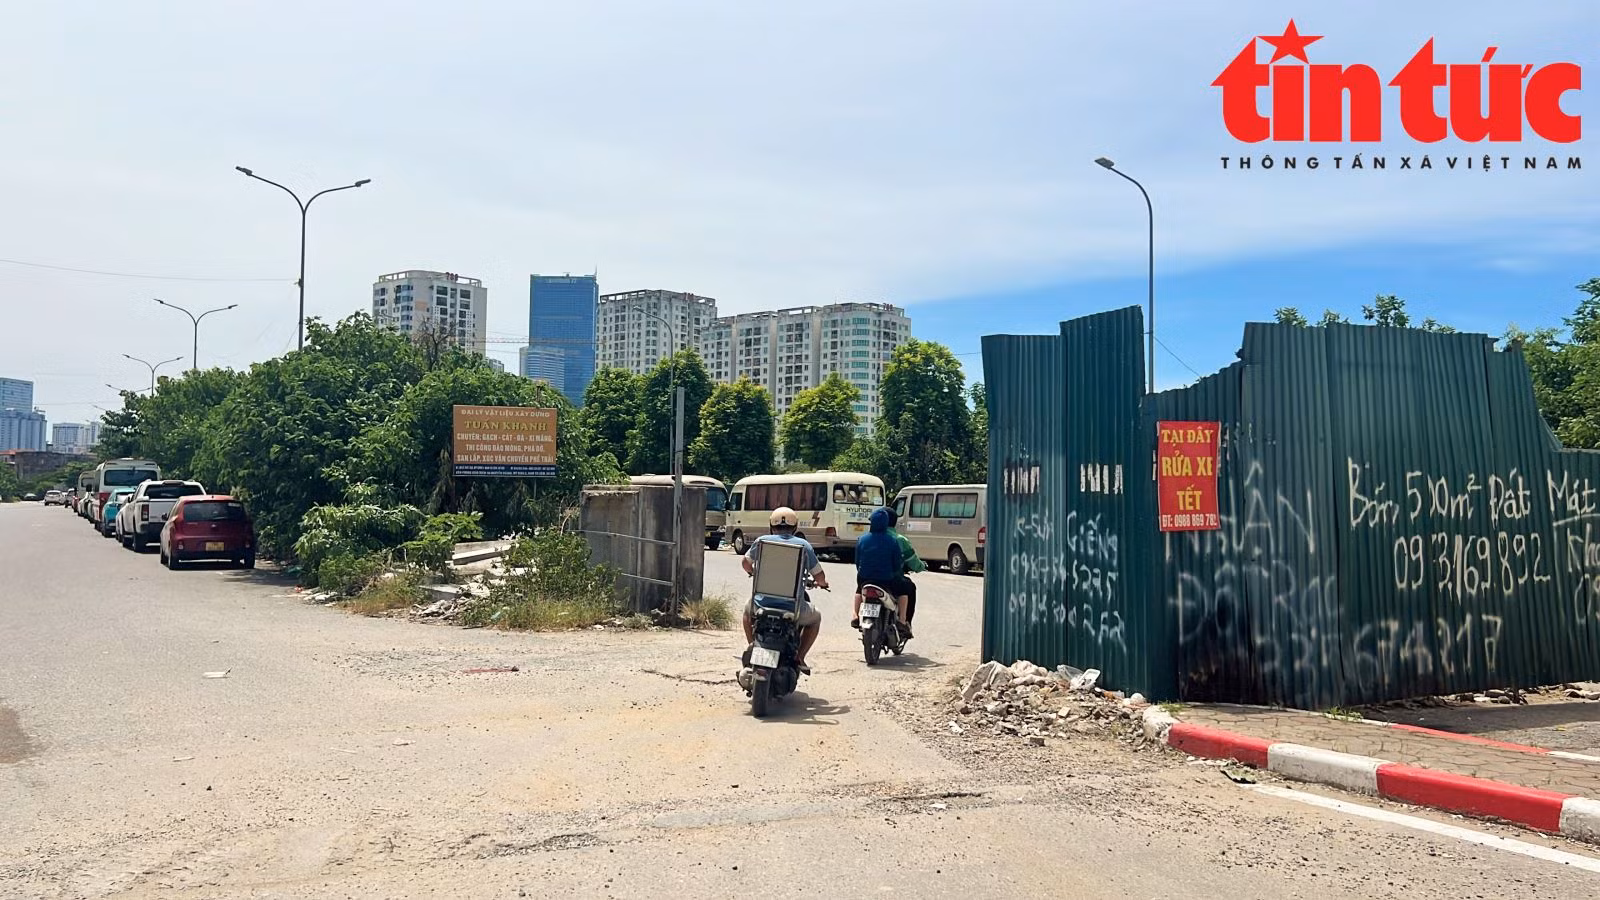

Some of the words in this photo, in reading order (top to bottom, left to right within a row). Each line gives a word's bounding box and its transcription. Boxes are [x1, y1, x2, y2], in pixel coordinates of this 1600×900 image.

[1161, 429, 1184, 447] TẠI
[1187, 426, 1214, 444] ĐÂY
[1161, 450, 1192, 477] RỬA
[1176, 484, 1202, 511] TẾT
